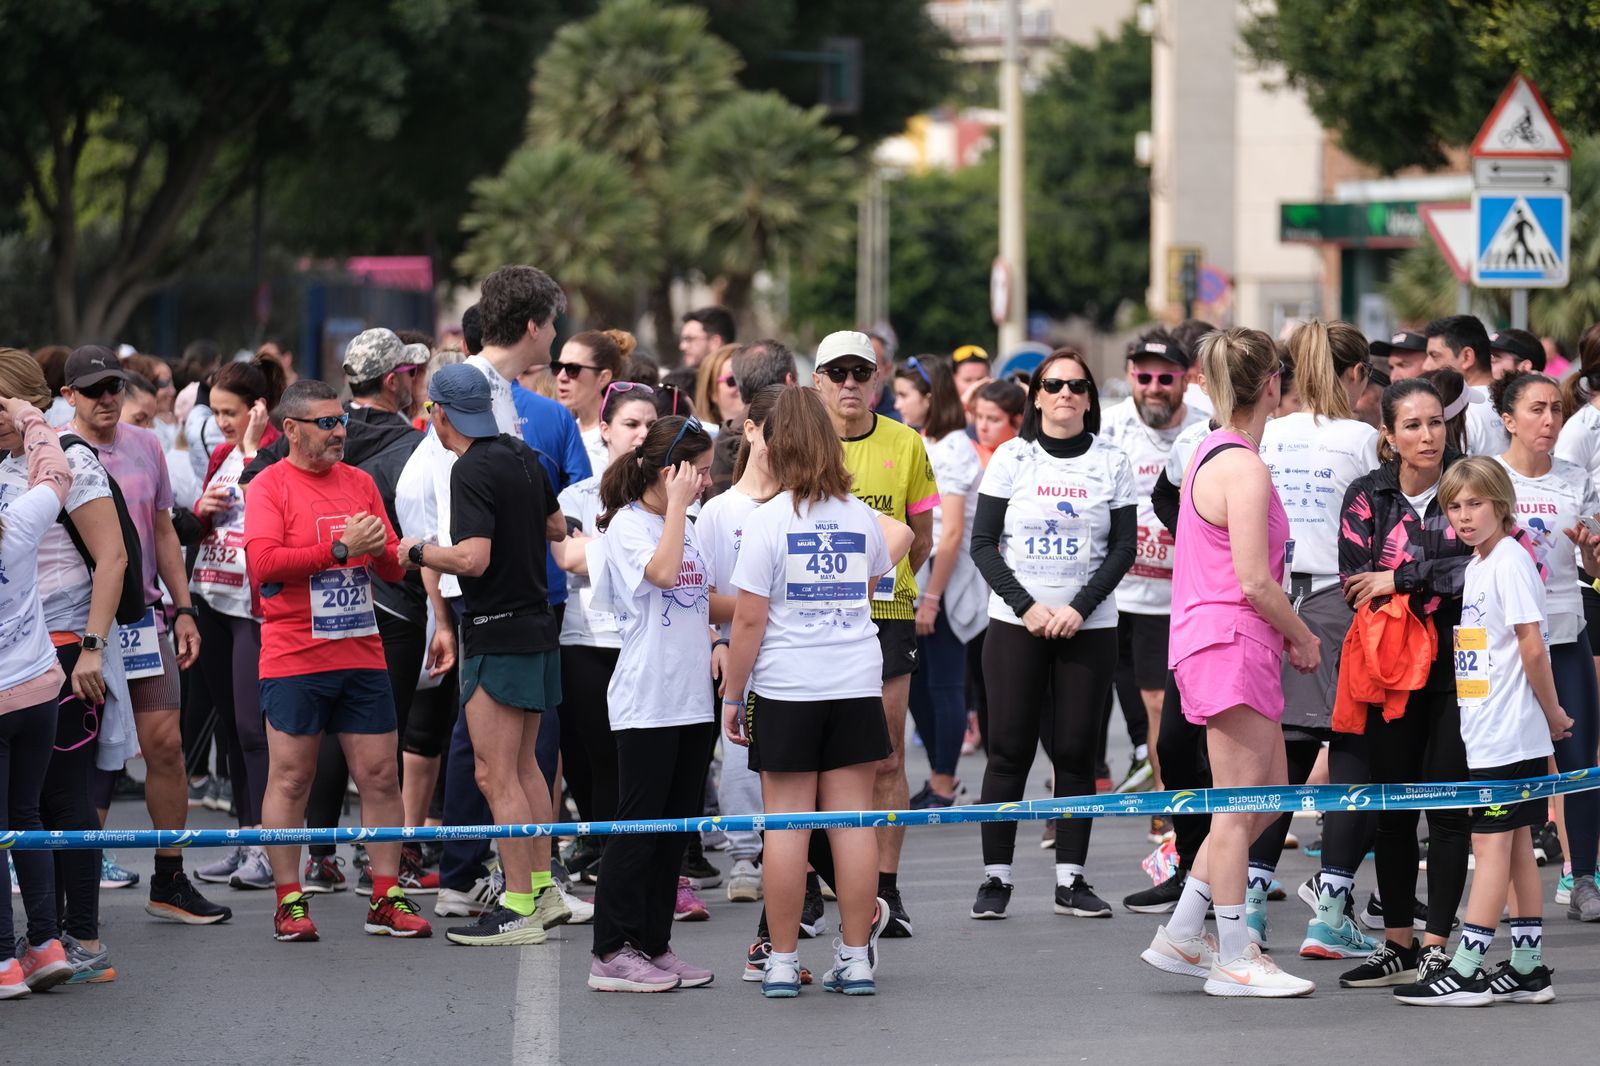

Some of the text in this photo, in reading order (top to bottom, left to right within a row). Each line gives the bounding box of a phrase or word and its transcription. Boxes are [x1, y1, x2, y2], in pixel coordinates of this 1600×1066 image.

[1138, 465, 1160, 475] MU
[1314, 468, 1333, 479] CASI
[1037, 485, 1088, 499] MUJER
[1025, 537, 1079, 556] 1315
[202, 545, 238, 564] 2532
[680, 560, 697, 573] INI
[806, 553, 848, 575] 430
[674, 573, 703, 587] UNNER
[322, 585, 368, 608] 2023
[1228, 794, 1281, 804] de Almería
[1390, 791, 1457, 802] Ayuntamiento
[1092, 804, 1104, 812] de
[1213, 802, 1281, 813] Ayuntamiento
[435, 824, 502, 834] Ayuntamiento
[610, 822, 678, 833] Ayuntamiento
[786, 821, 853, 830] Ayuntamiento
[83, 832, 136, 842] de Almería
[259, 832, 311, 842] de Almería
[498, 917, 529, 934] HOKA
